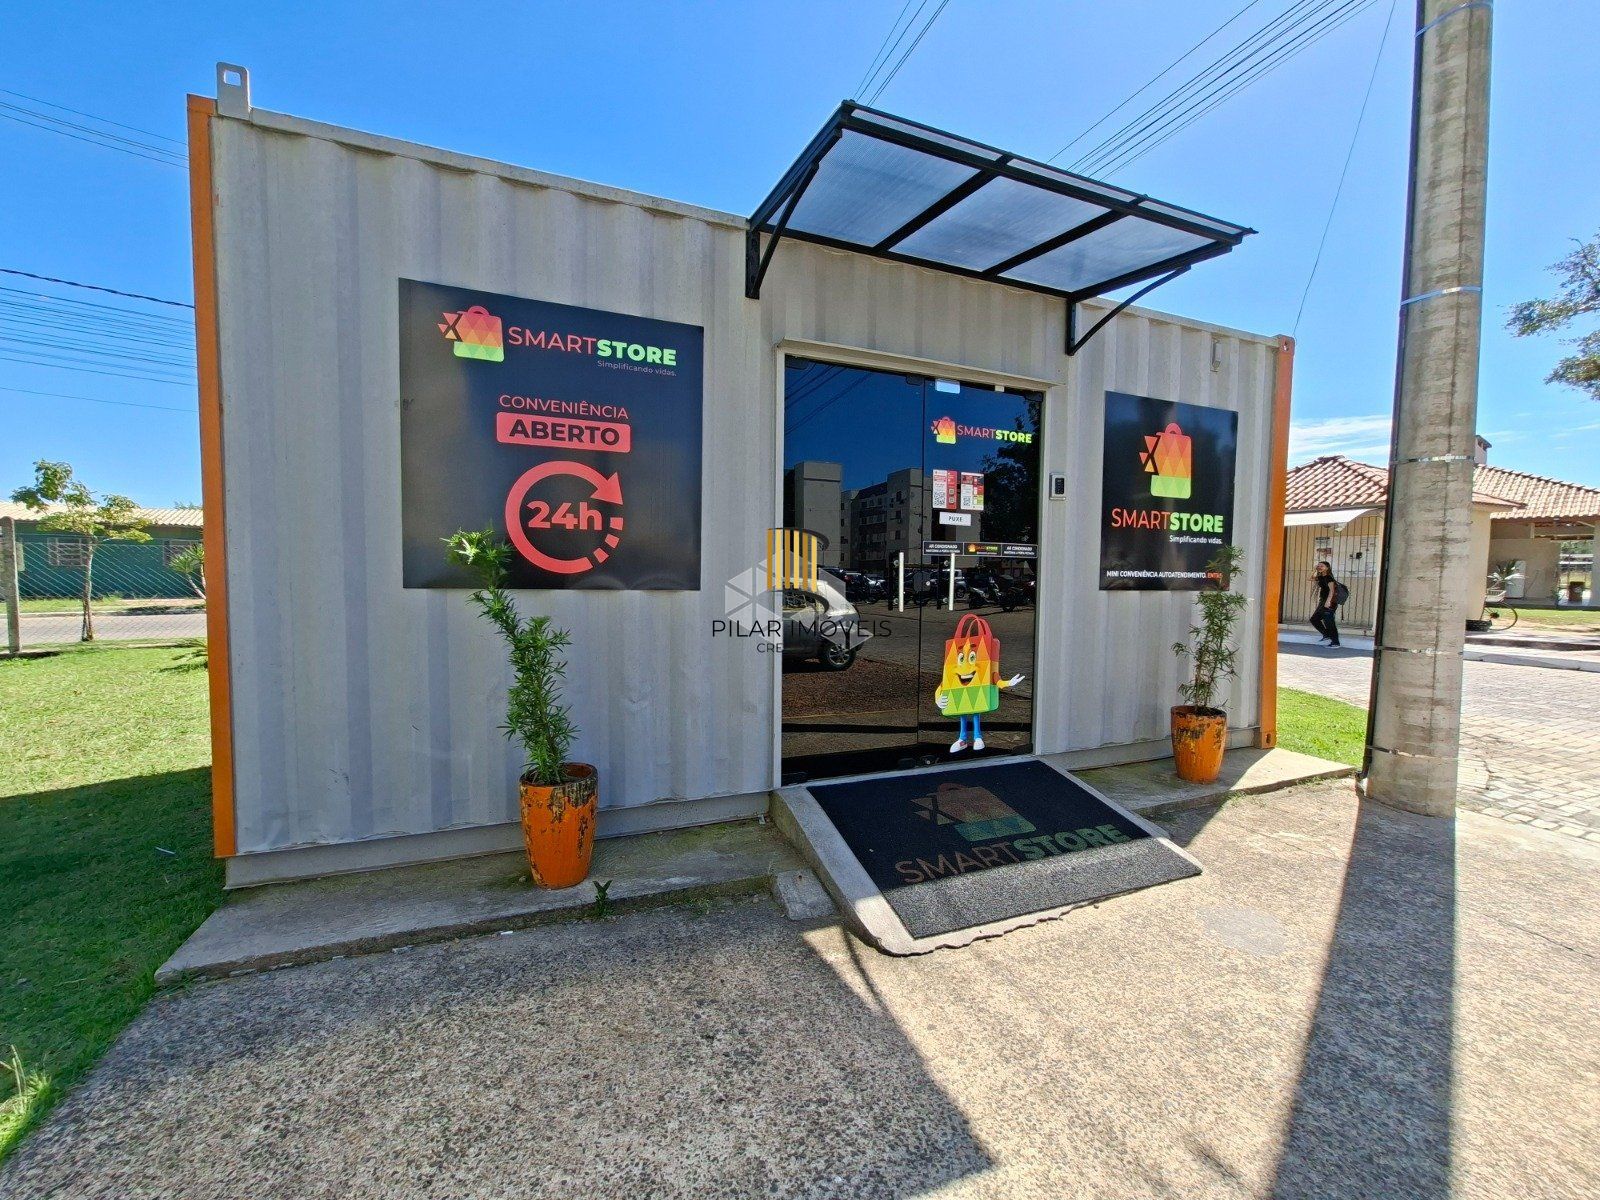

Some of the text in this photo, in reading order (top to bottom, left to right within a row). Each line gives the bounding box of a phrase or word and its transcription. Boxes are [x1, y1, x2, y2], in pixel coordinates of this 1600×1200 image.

[508, 326, 676, 366] SMARTSTORE
[597, 359, 677, 377] Simplificando vidas.
[499, 394, 629, 420] CONVENIÊNCIA
[509, 419, 620, 446] ABERTO
[957, 425, 1032, 444] SMARTSTORE
[526, 500, 603, 531] 24h
[1111, 508, 1223, 532] SMARTSTORE
[1169, 534, 1207, 545] Simplificando
[1106, 570, 1119, 578] MINI
[1119, 569, 1158, 578] CONVENIÊNCIA
[895, 824, 1130, 884] SMARTSTORE
